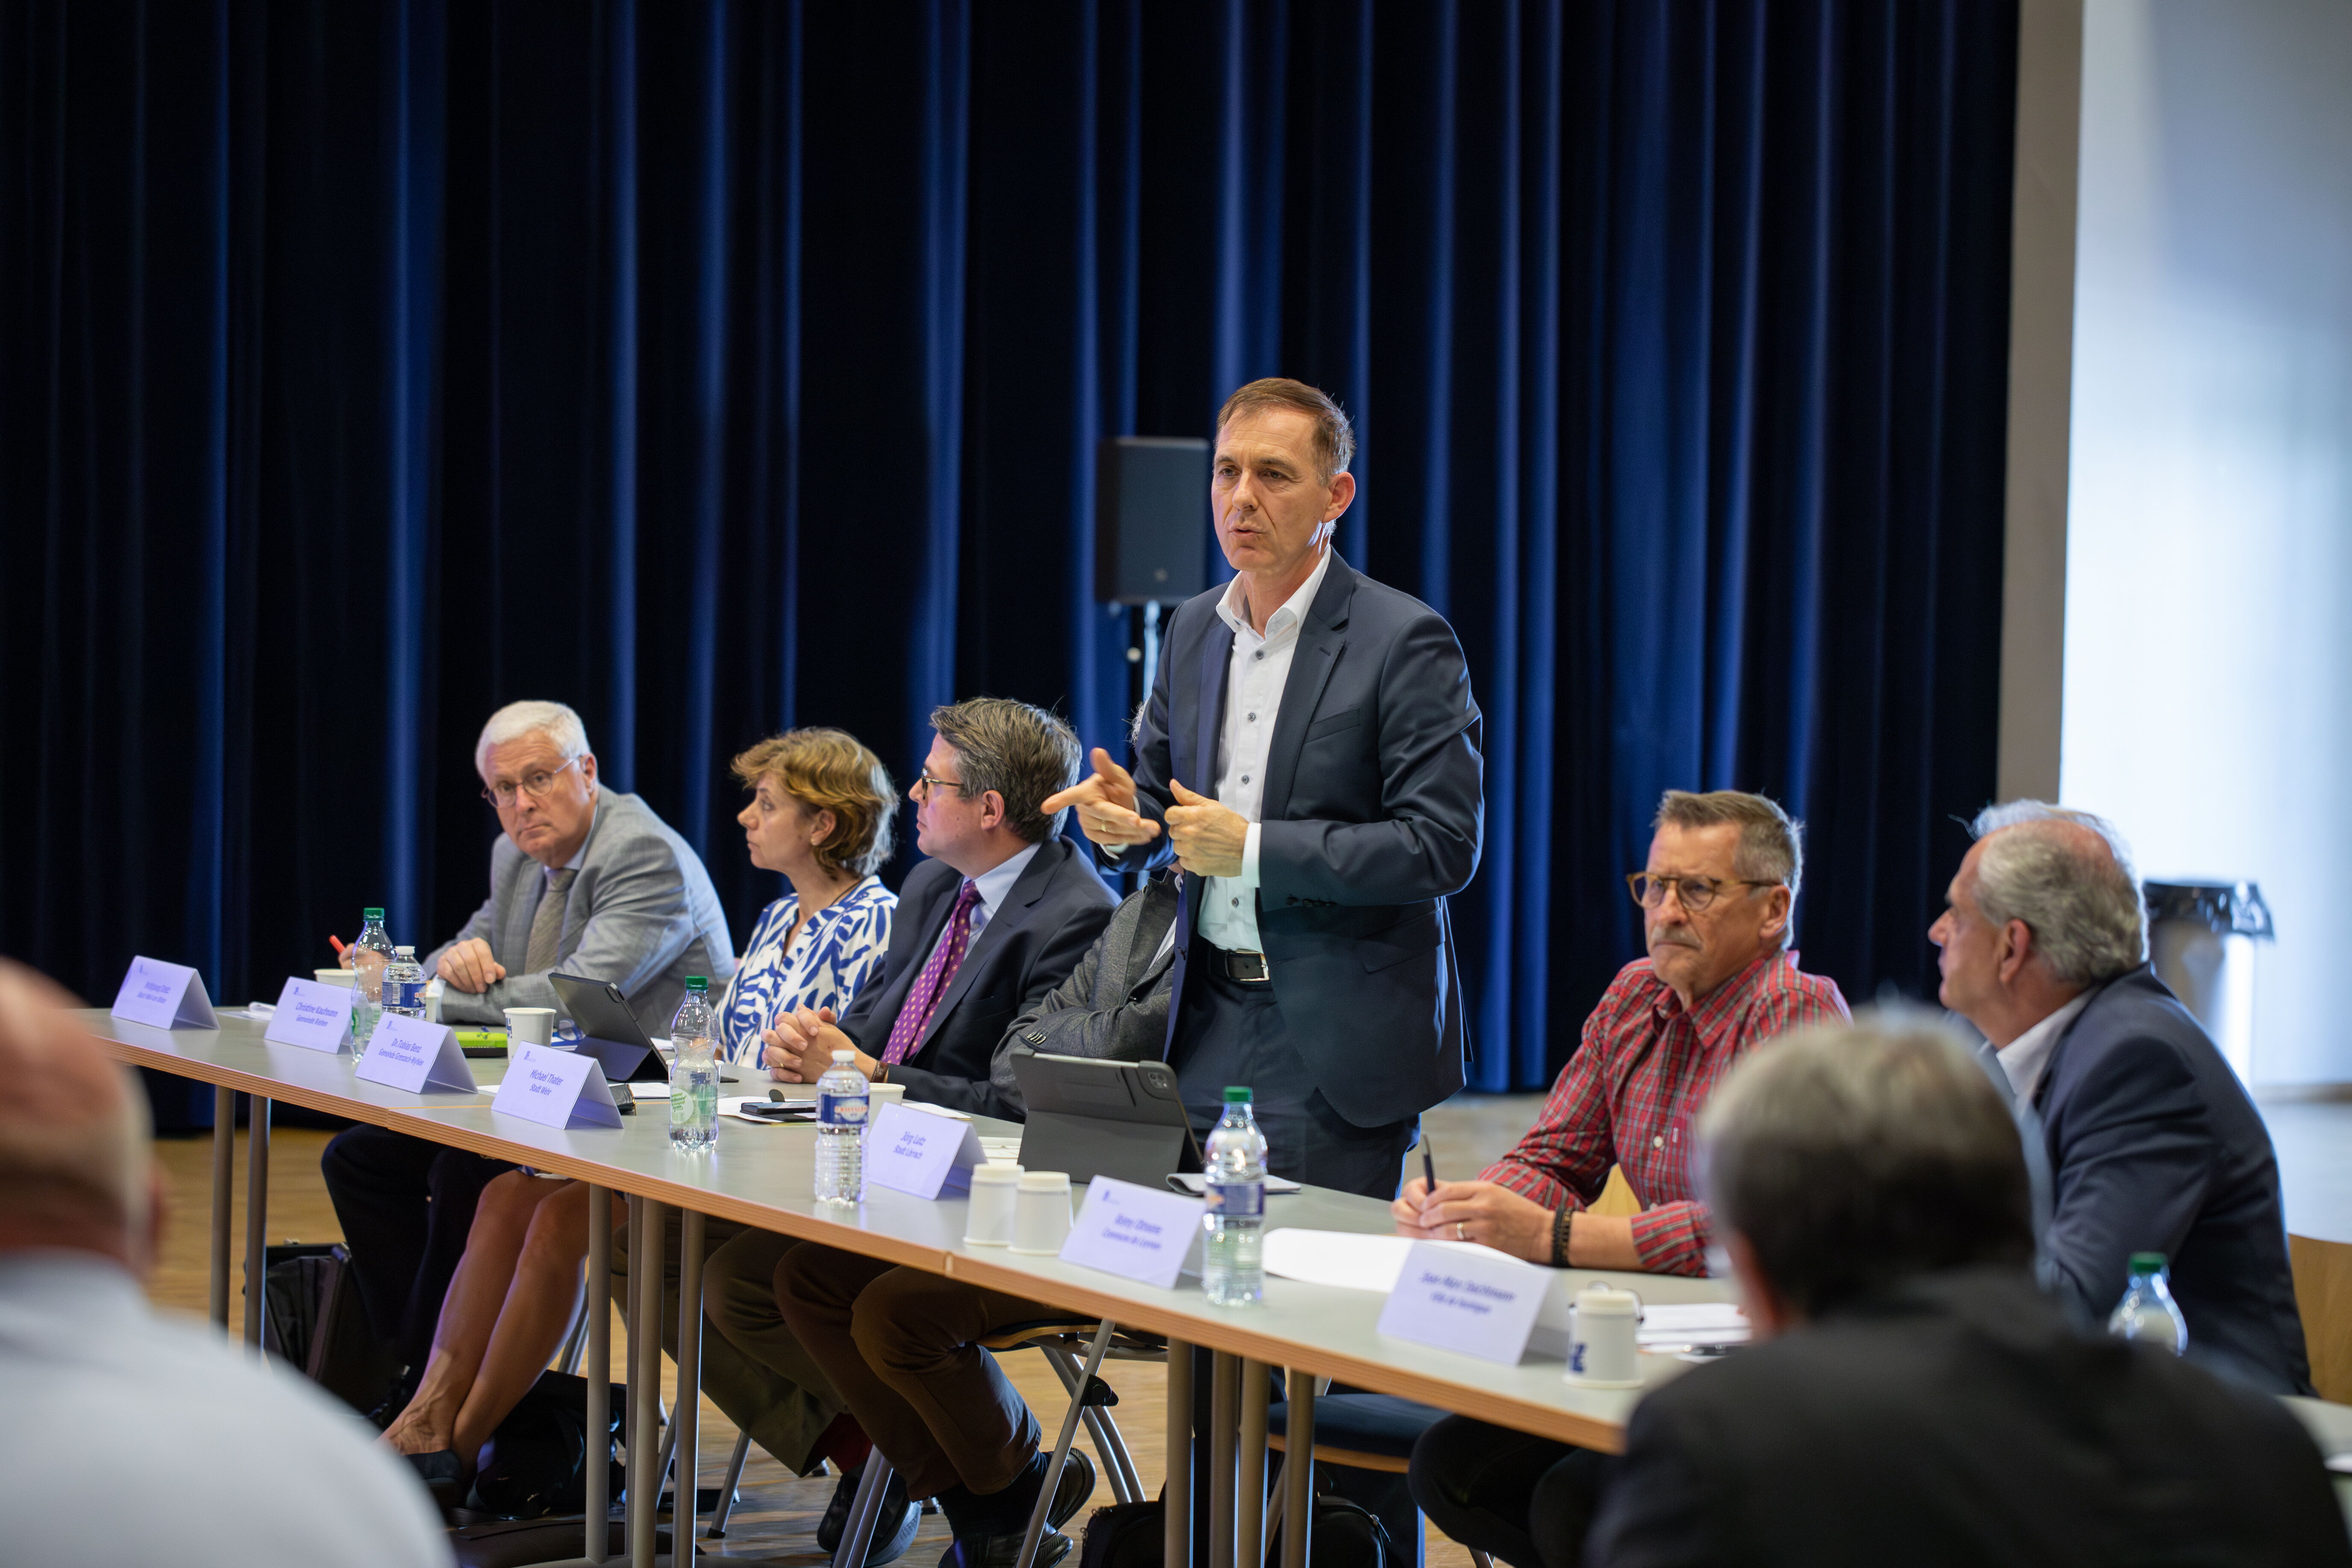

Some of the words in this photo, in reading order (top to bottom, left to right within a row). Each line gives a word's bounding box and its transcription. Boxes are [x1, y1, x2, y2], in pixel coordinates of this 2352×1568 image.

[410, 1043, 422, 1053] Benz
[529, 1069, 550, 1081] Michael
[547, 1074, 564, 1086] Thater
[529, 1084, 541, 1093] Stadt
[541, 1087, 552, 1095] Wehr
